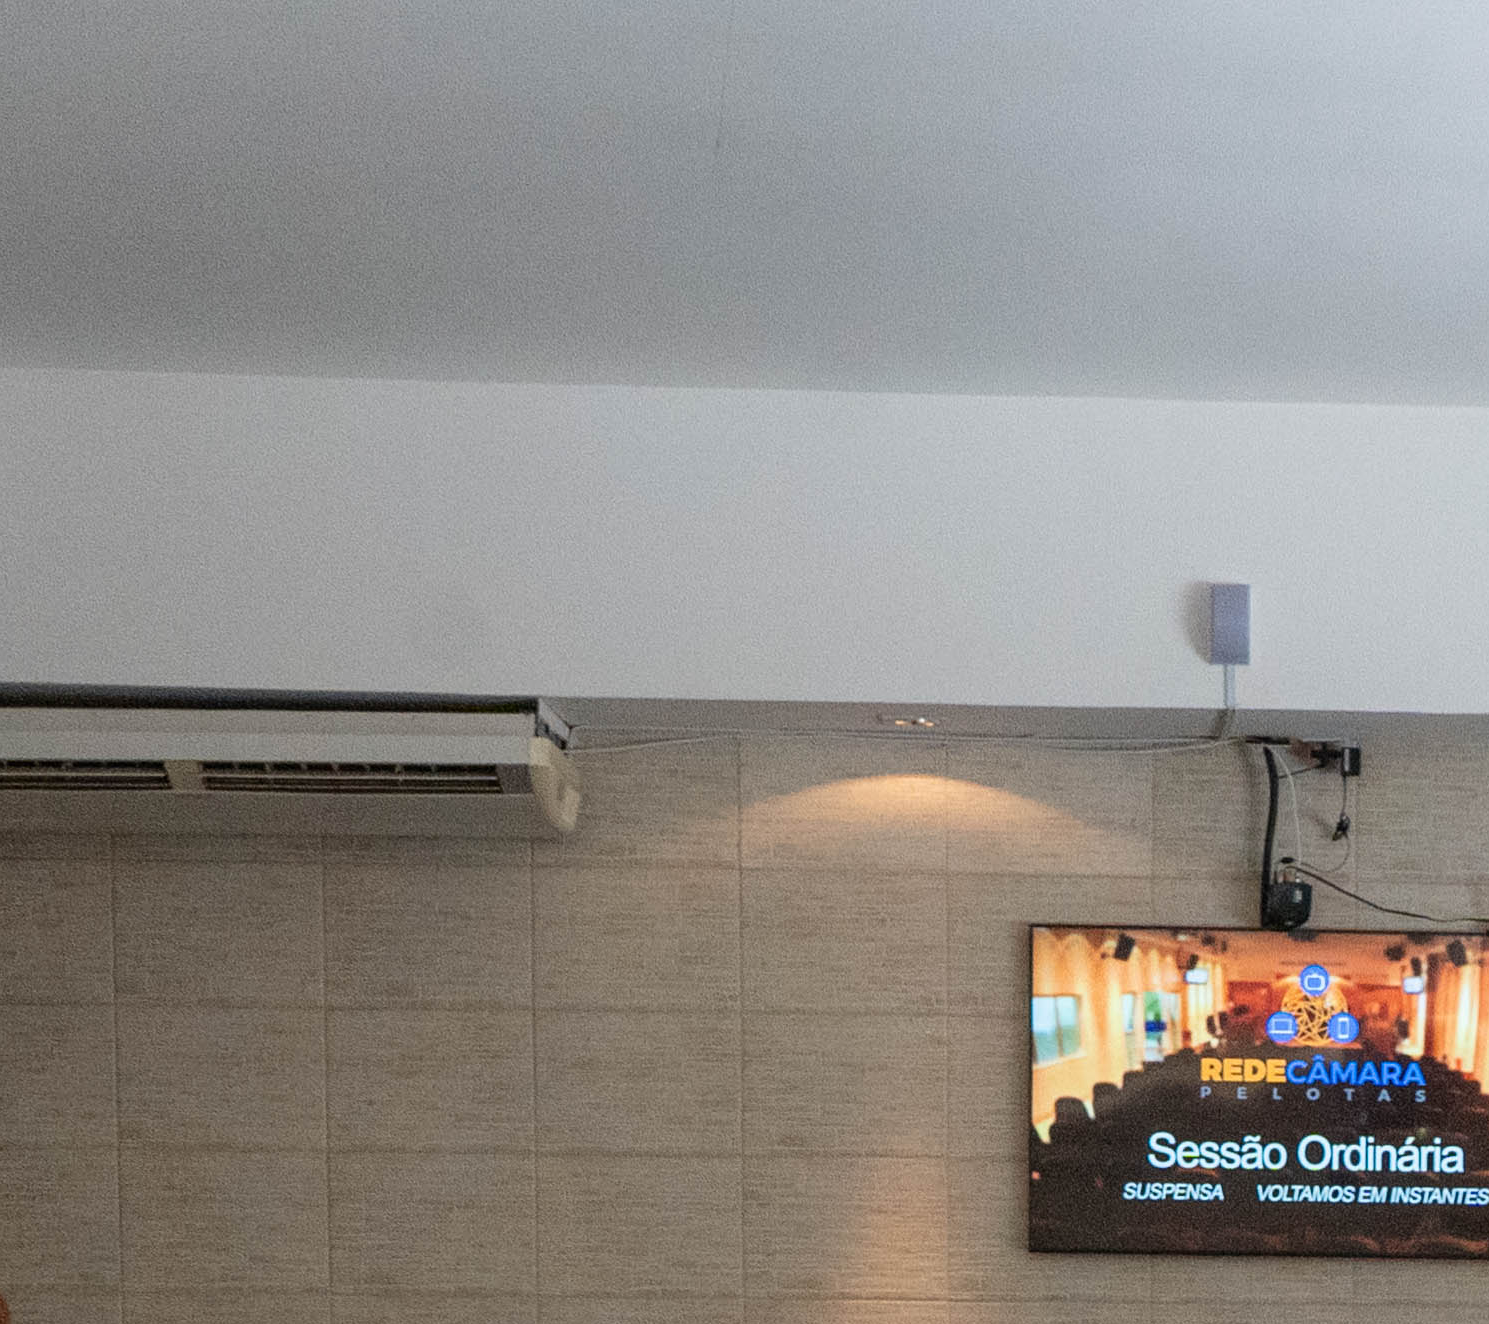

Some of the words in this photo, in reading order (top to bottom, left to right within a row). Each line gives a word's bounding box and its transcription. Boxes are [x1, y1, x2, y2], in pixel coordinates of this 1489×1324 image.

[1200, 1054, 1426, 1086] REDECÂMARA
[1200, 1086, 1426, 1102] PELOTAS
[1147, 1131, 1287, 1170] Sessão
[1297, 1134, 1465, 1173] Ordinária
[1122, 1182, 1225, 1201] SUSPENSA
[1257, 1184, 1356, 1204] VOLTAMOS
[1357, 1187, 1390, 1204] EM
